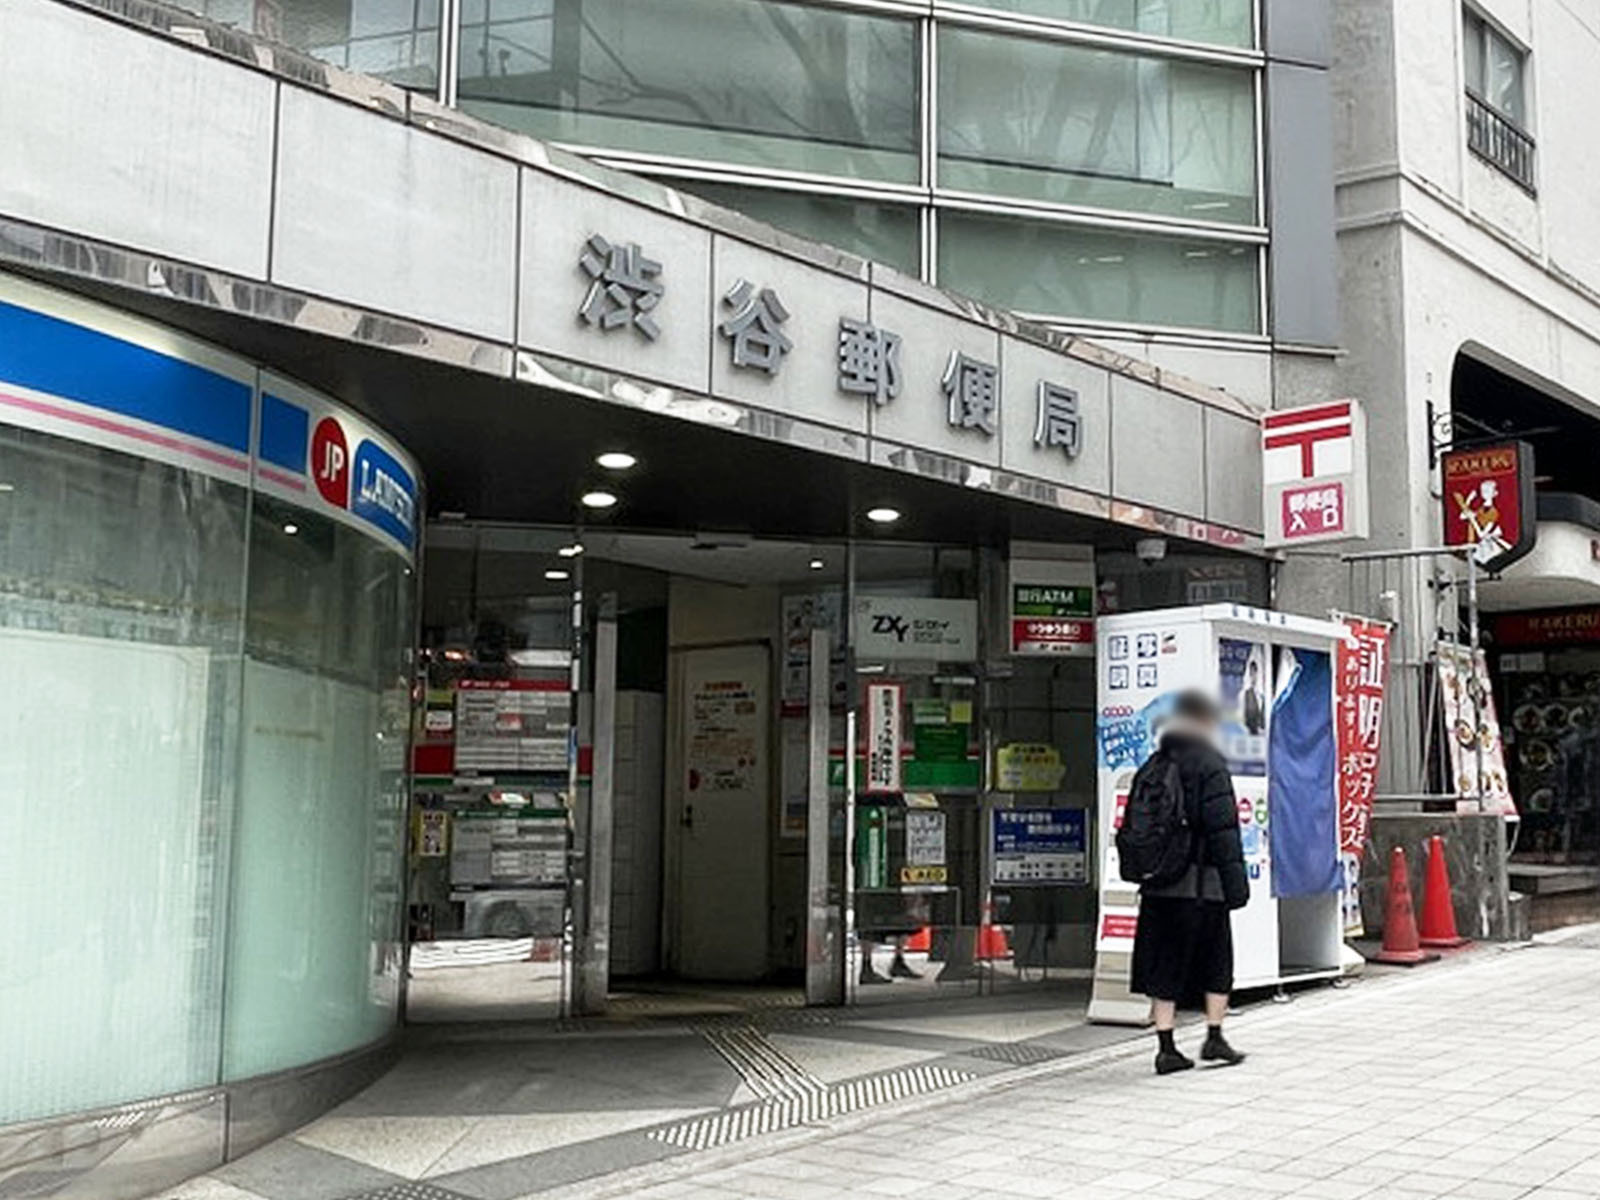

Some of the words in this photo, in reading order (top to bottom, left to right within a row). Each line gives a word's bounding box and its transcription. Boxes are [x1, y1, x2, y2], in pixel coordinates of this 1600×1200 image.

[579, 233, 1085, 459] 渋谷郵便局
[321, 441, 344, 482] JP
[1289, 488, 1339, 513] 郵便局
[1289, 509, 1339, 533] 入口
[872, 615, 909, 642] ZXY
